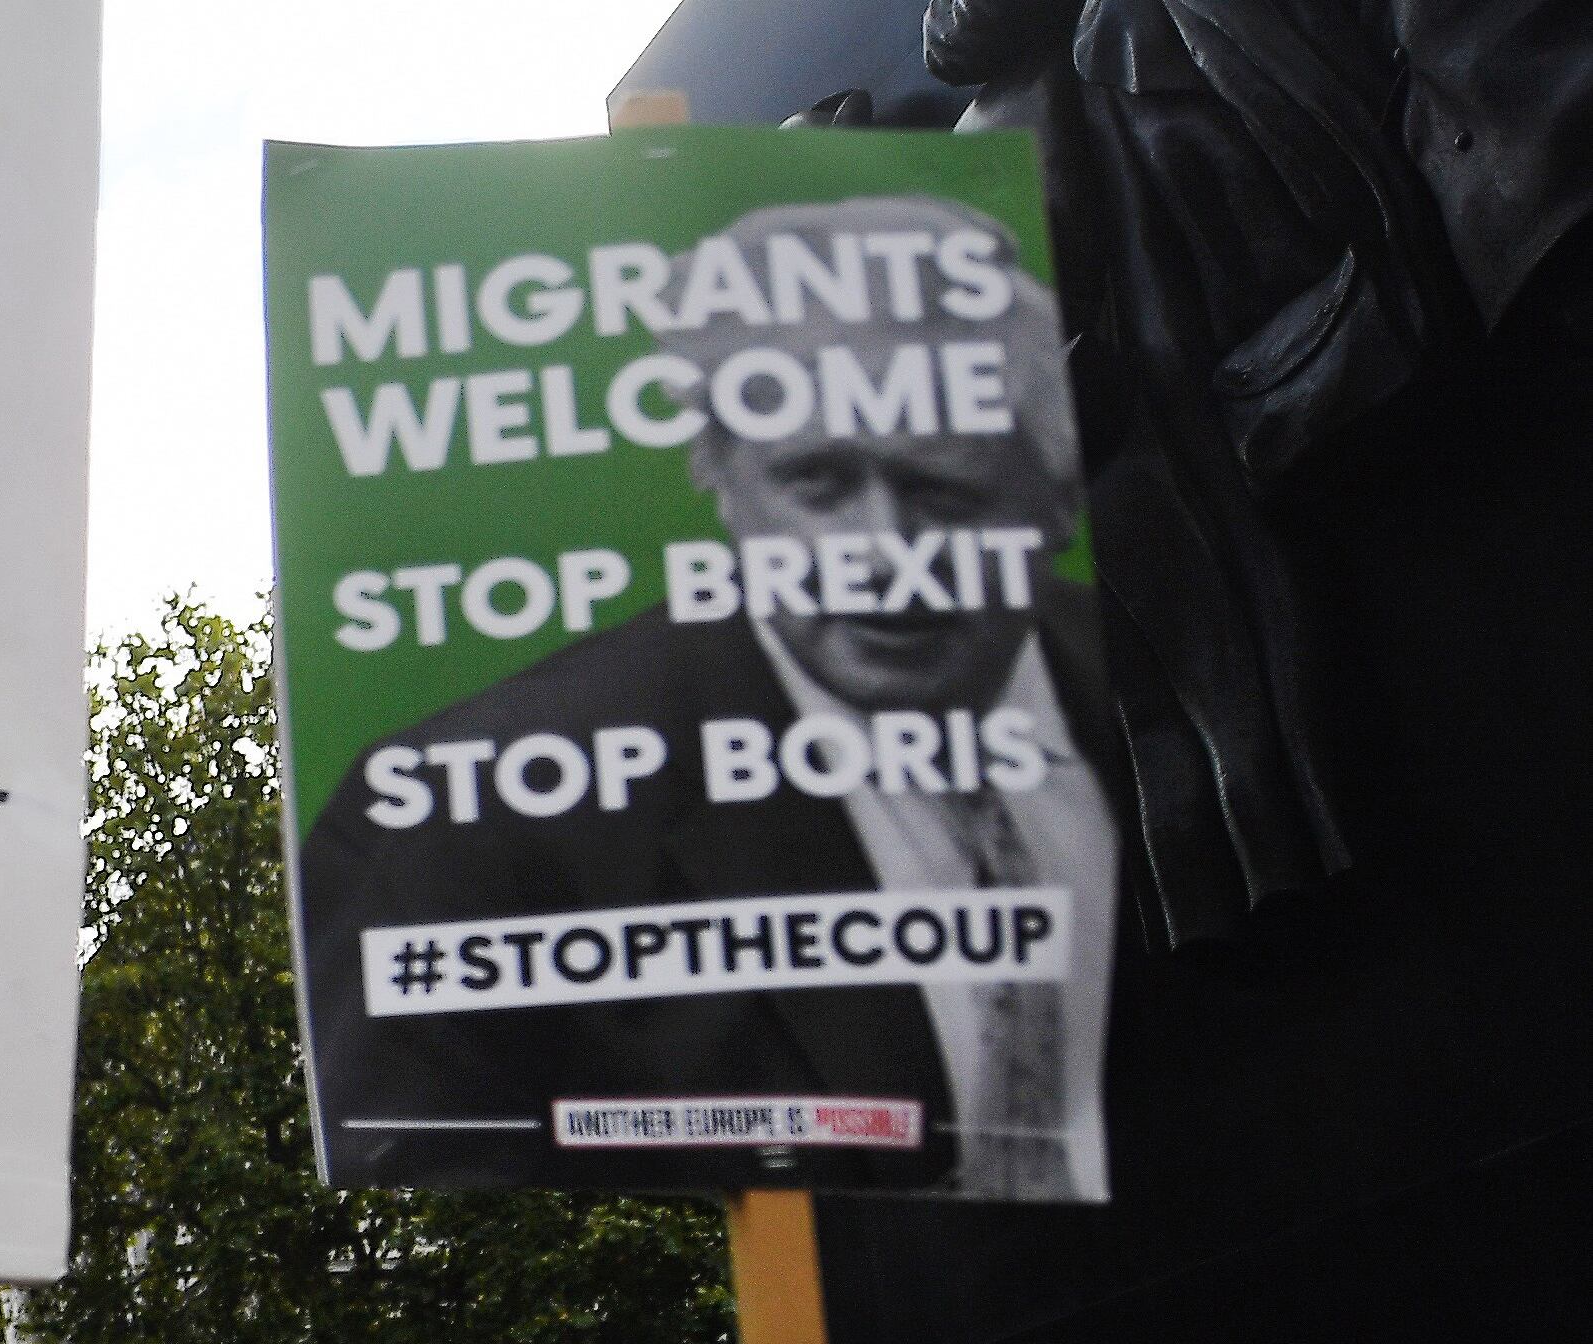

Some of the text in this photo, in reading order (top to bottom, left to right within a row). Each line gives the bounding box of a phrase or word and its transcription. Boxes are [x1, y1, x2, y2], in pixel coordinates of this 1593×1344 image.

[306, 230, 1013, 367] MIGRANTS
[318, 340, 1012, 479] WELCOME
[331, 525, 1041, 653] STOP BREXIT
[363, 706, 1046, 830] STOP BORIS
[391, 904, 1053, 997] #STOPTHECOUP
